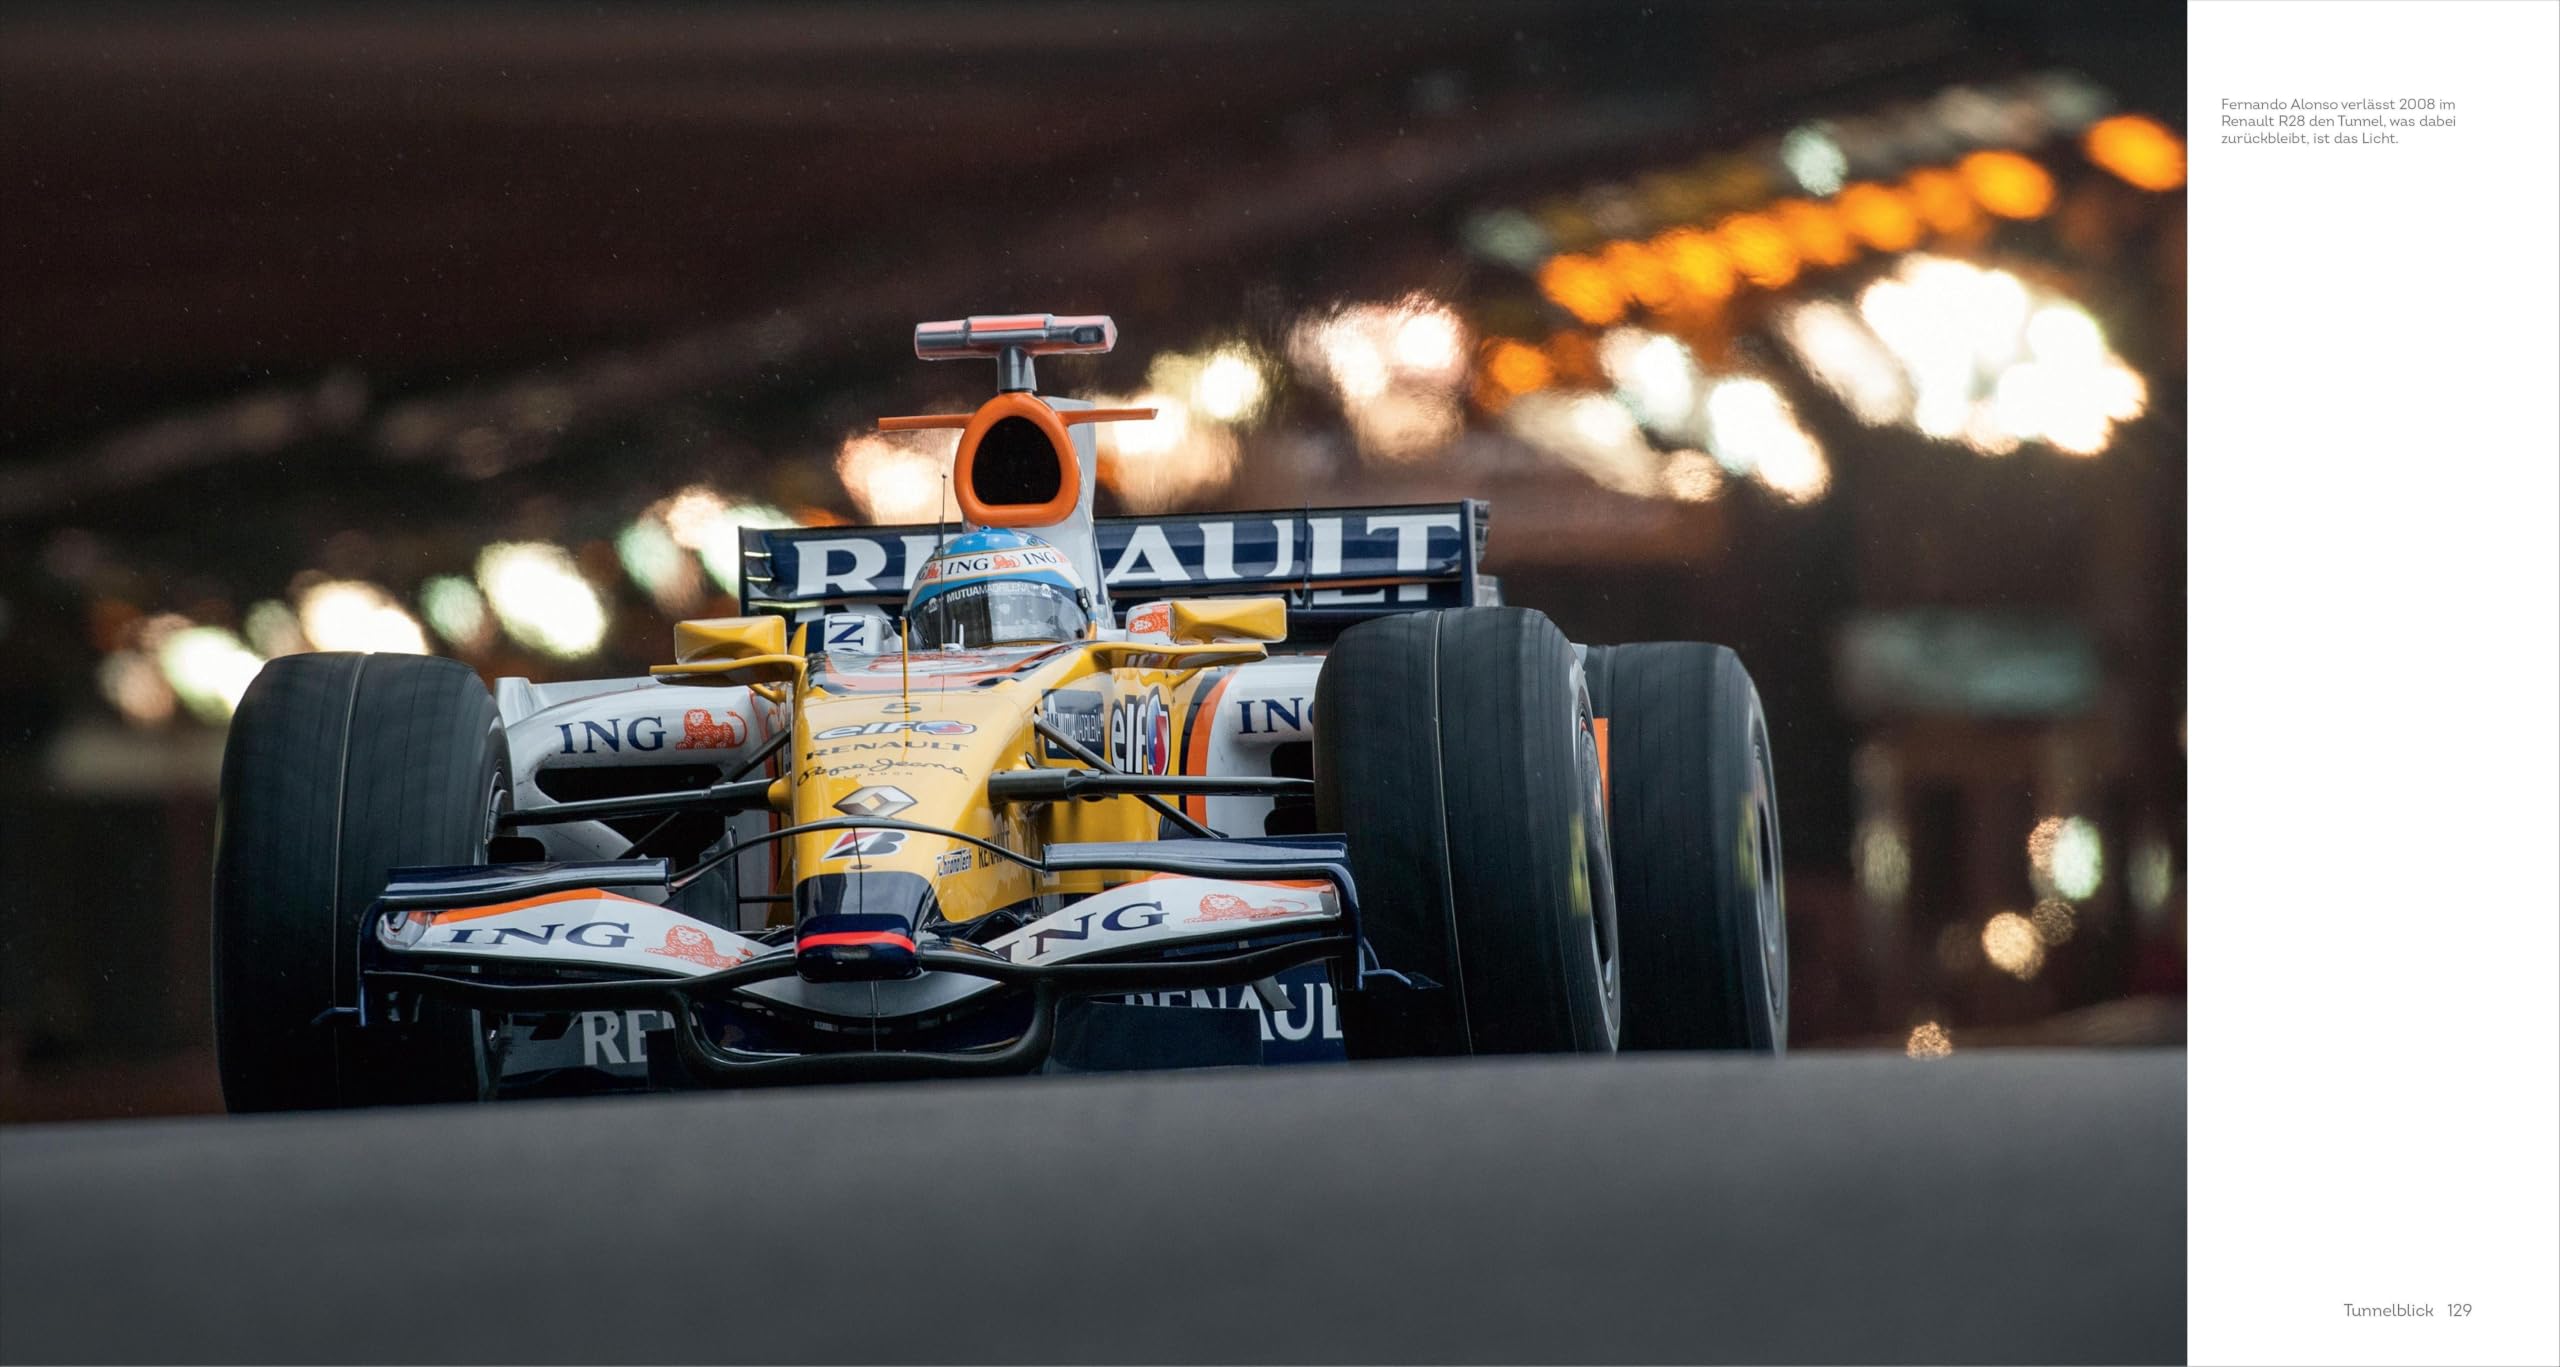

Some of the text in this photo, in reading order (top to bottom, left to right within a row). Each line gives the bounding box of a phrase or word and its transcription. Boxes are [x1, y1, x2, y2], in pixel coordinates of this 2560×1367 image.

[947, 557, 989, 576] ING
[1022, 551, 1057, 566] ING
[881, 702, 923, 714] 5
[1236, 697, 1314, 735] IN
[555, 716, 667, 755] ING
[1110, 697, 1147, 774] elf
[806, 741, 968, 760] RENAULT
[442, 921, 635, 948] ING
